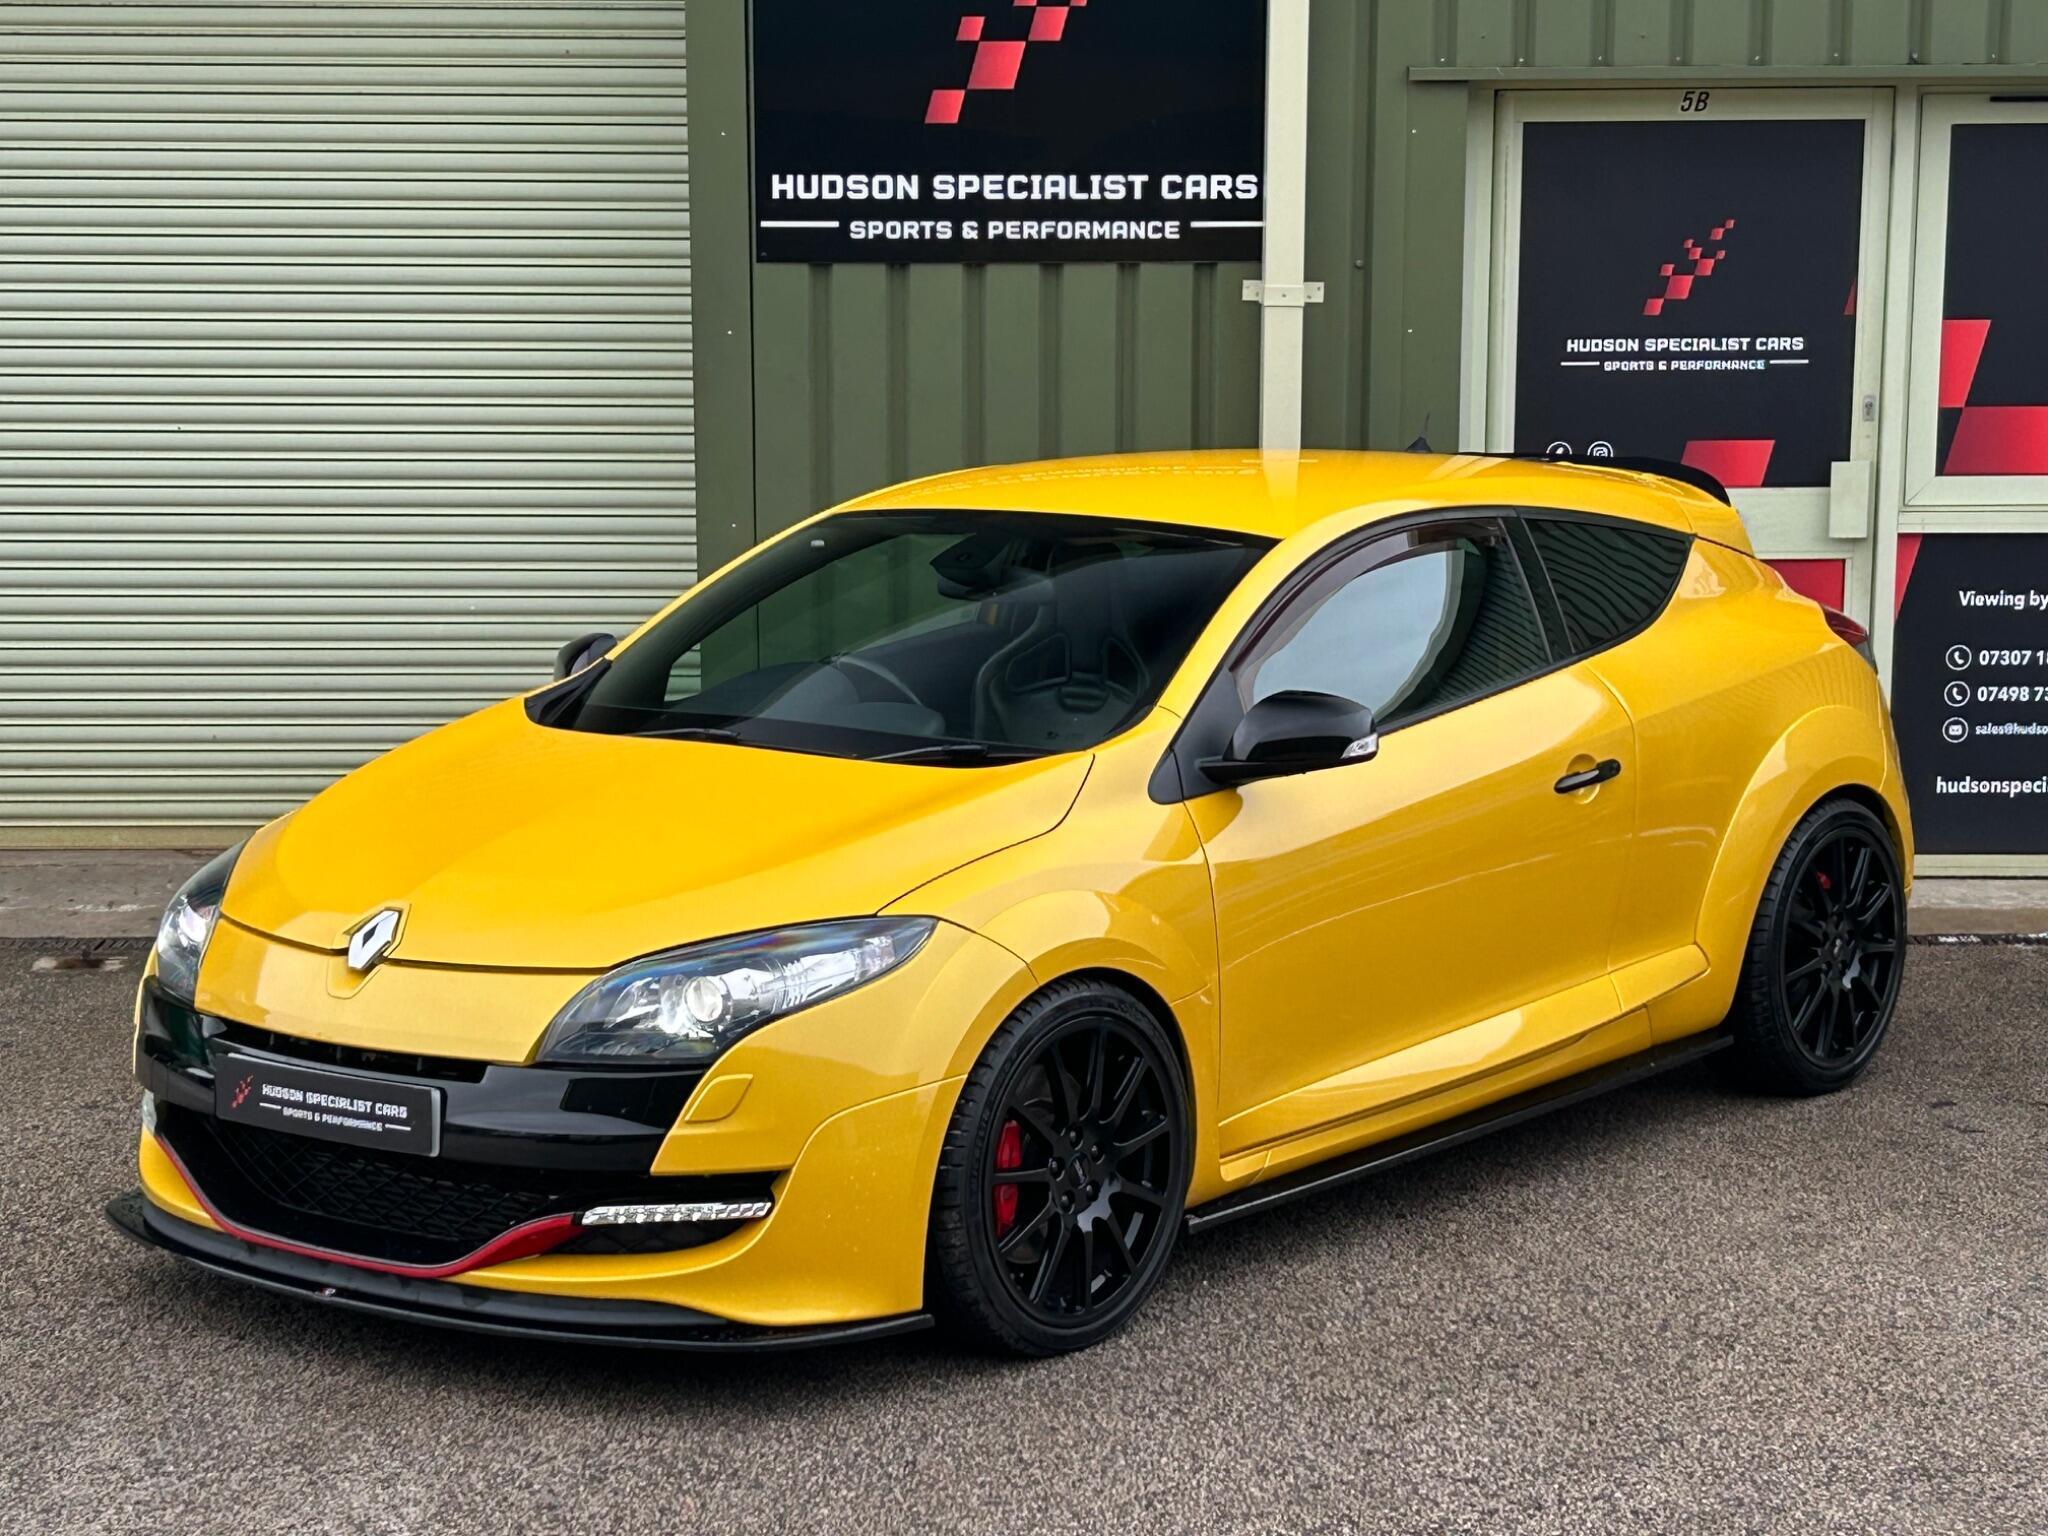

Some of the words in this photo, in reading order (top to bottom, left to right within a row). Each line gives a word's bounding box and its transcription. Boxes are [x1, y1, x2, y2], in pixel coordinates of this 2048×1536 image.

[1681, 91, 1710, 112] 5B
[772, 174, 918, 199] HUDSON
[933, 175, 1149, 199] SPECIALIST
[1161, 175, 1258, 199] CARS
[850, 221, 952, 239] SPORTS
[962, 221, 978, 239] &
[988, 221, 1180, 239] PERFORMANCE
[1567, 339, 1639, 352] HUDSON
[1645, 338, 1751, 351] SPECIALIST
[1756, 337, 1804, 350] CARS
[1604, 361, 1654, 371] SPORTS
[1658, 361, 1667, 370] &
[1671, 360, 1765, 370] PERFORMANCE
[1959, 590, 2025, 610] Viewing
[2030, 590, 2048, 610] by
[1979, 650, 2032, 665] 07307
[2037, 650, 2048, 665] 1
[1977, 686, 2029, 701] 07498
[1936, 776, 2048, 798] hudsonspeci
[262, 1083, 303, 1103] HUDSON
[306, 1091, 372, 1113] SPECIALIST
[375, 1103, 408, 1119] CARS
[322, 1113, 383, 1132] PERFORMANCE
